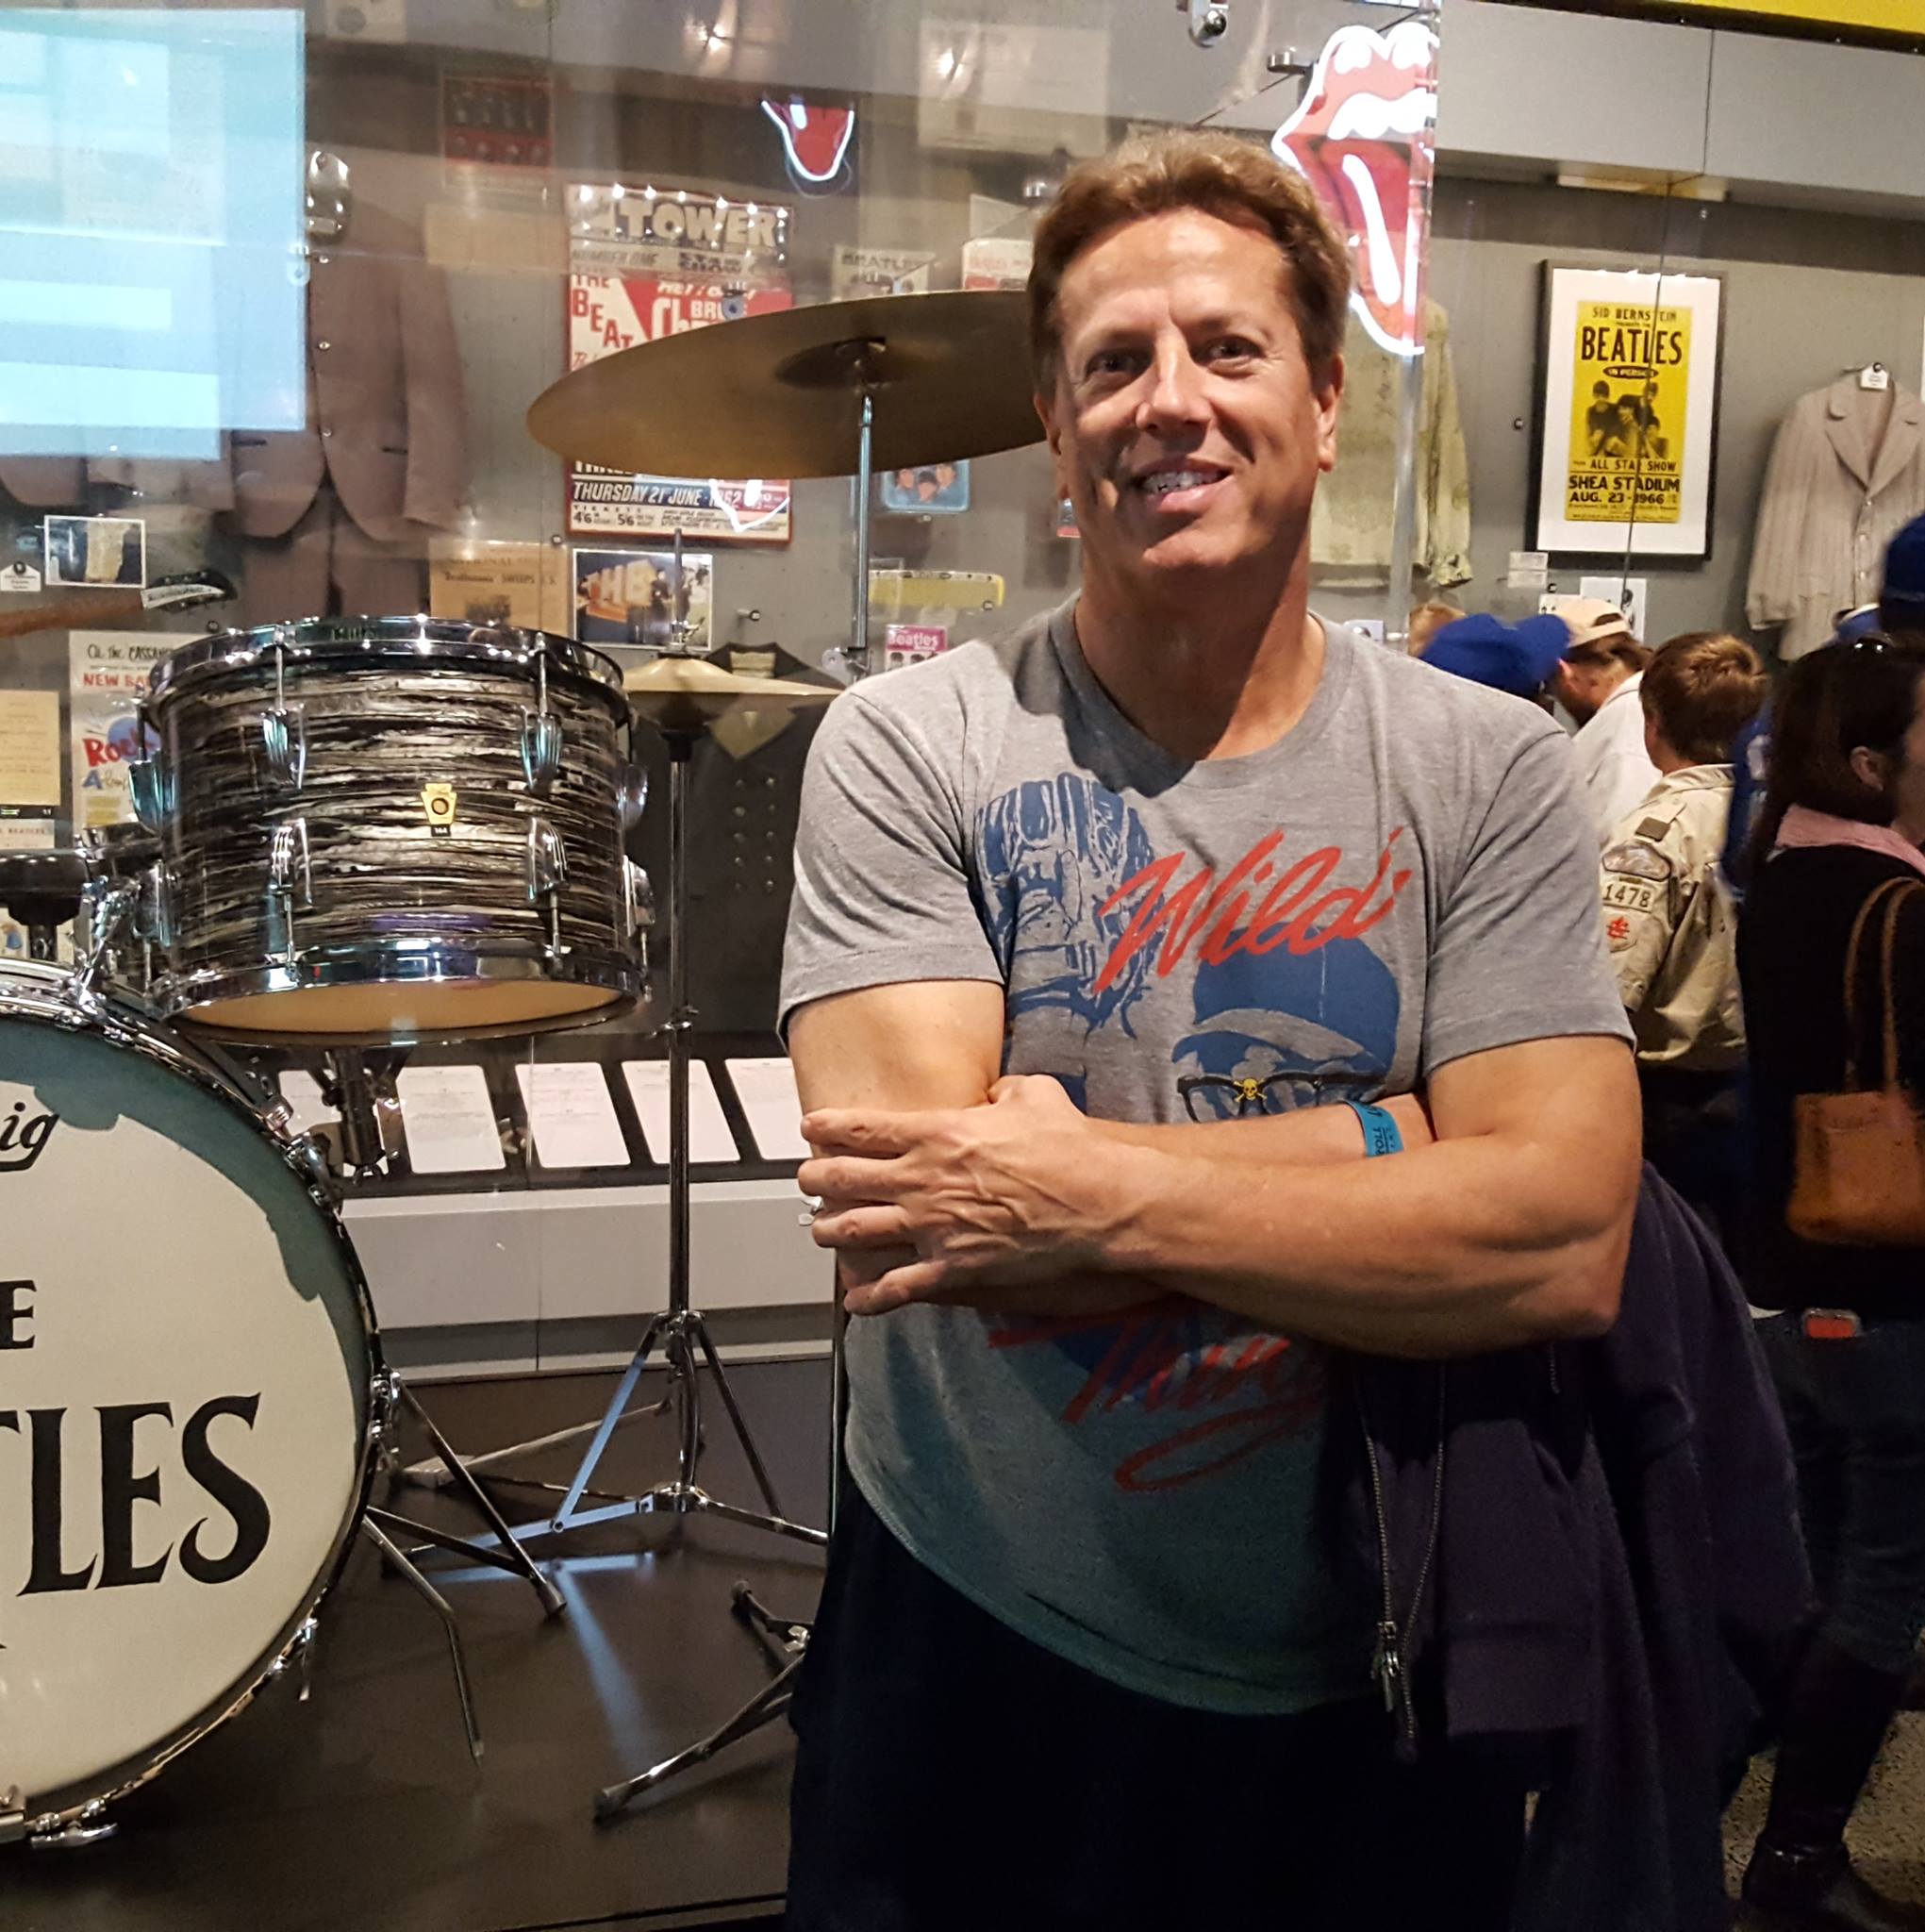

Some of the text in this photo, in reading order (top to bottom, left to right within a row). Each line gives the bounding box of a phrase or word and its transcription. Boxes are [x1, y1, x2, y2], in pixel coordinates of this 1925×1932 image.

[617, 199, 777, 248] TOWER
[1593, 308, 1678, 322] SID BERNSEIN
[1581, 325, 1683, 365] BEATLES
[1590, 458, 1609, 470] ALL
[1615, 459, 1640, 471] STA
[1647, 460, 1677, 472] SHOW
[1568, 475, 1680, 492] SHEA STADIUM
[573, 482, 649, 502] THURSDAY
[667, 487, 703, 507] JUNE
[1569, 491, 1602, 502] AUG.
[83, 674, 119, 687] NEW
[1602, 884, 1651, 908] 1478
